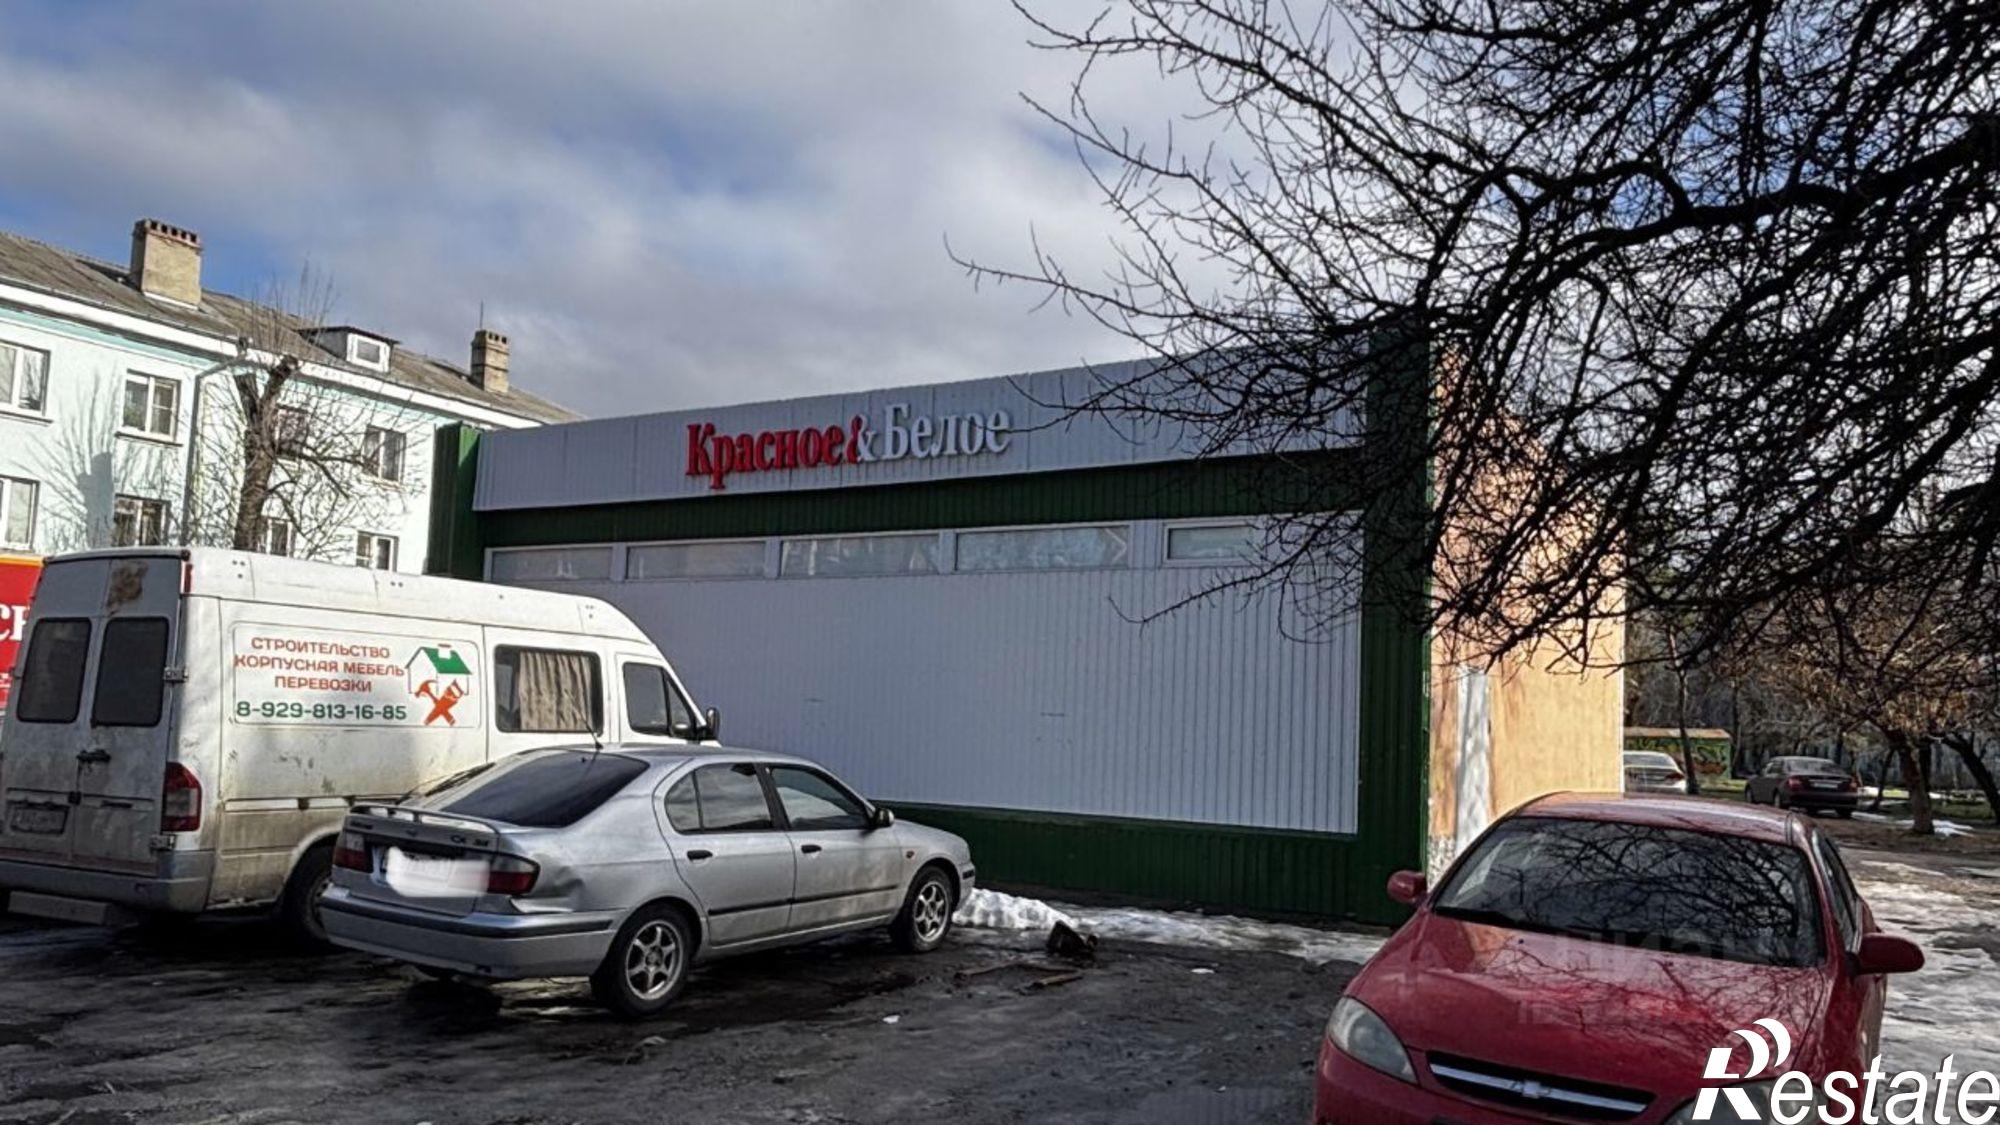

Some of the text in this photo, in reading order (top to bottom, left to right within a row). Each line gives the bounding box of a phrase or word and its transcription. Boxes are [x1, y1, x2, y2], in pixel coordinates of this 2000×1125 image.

[251, 637, 390, 659] СТРОИТЕЛЬСТВО
[234, 654, 405, 677] КОРПУСНАЯ МЕБЕЛЬ
[275, 676, 372, 692] ПЕРЕВОЗКИ
[236, 701, 407, 720] 8-929-813-16-85
